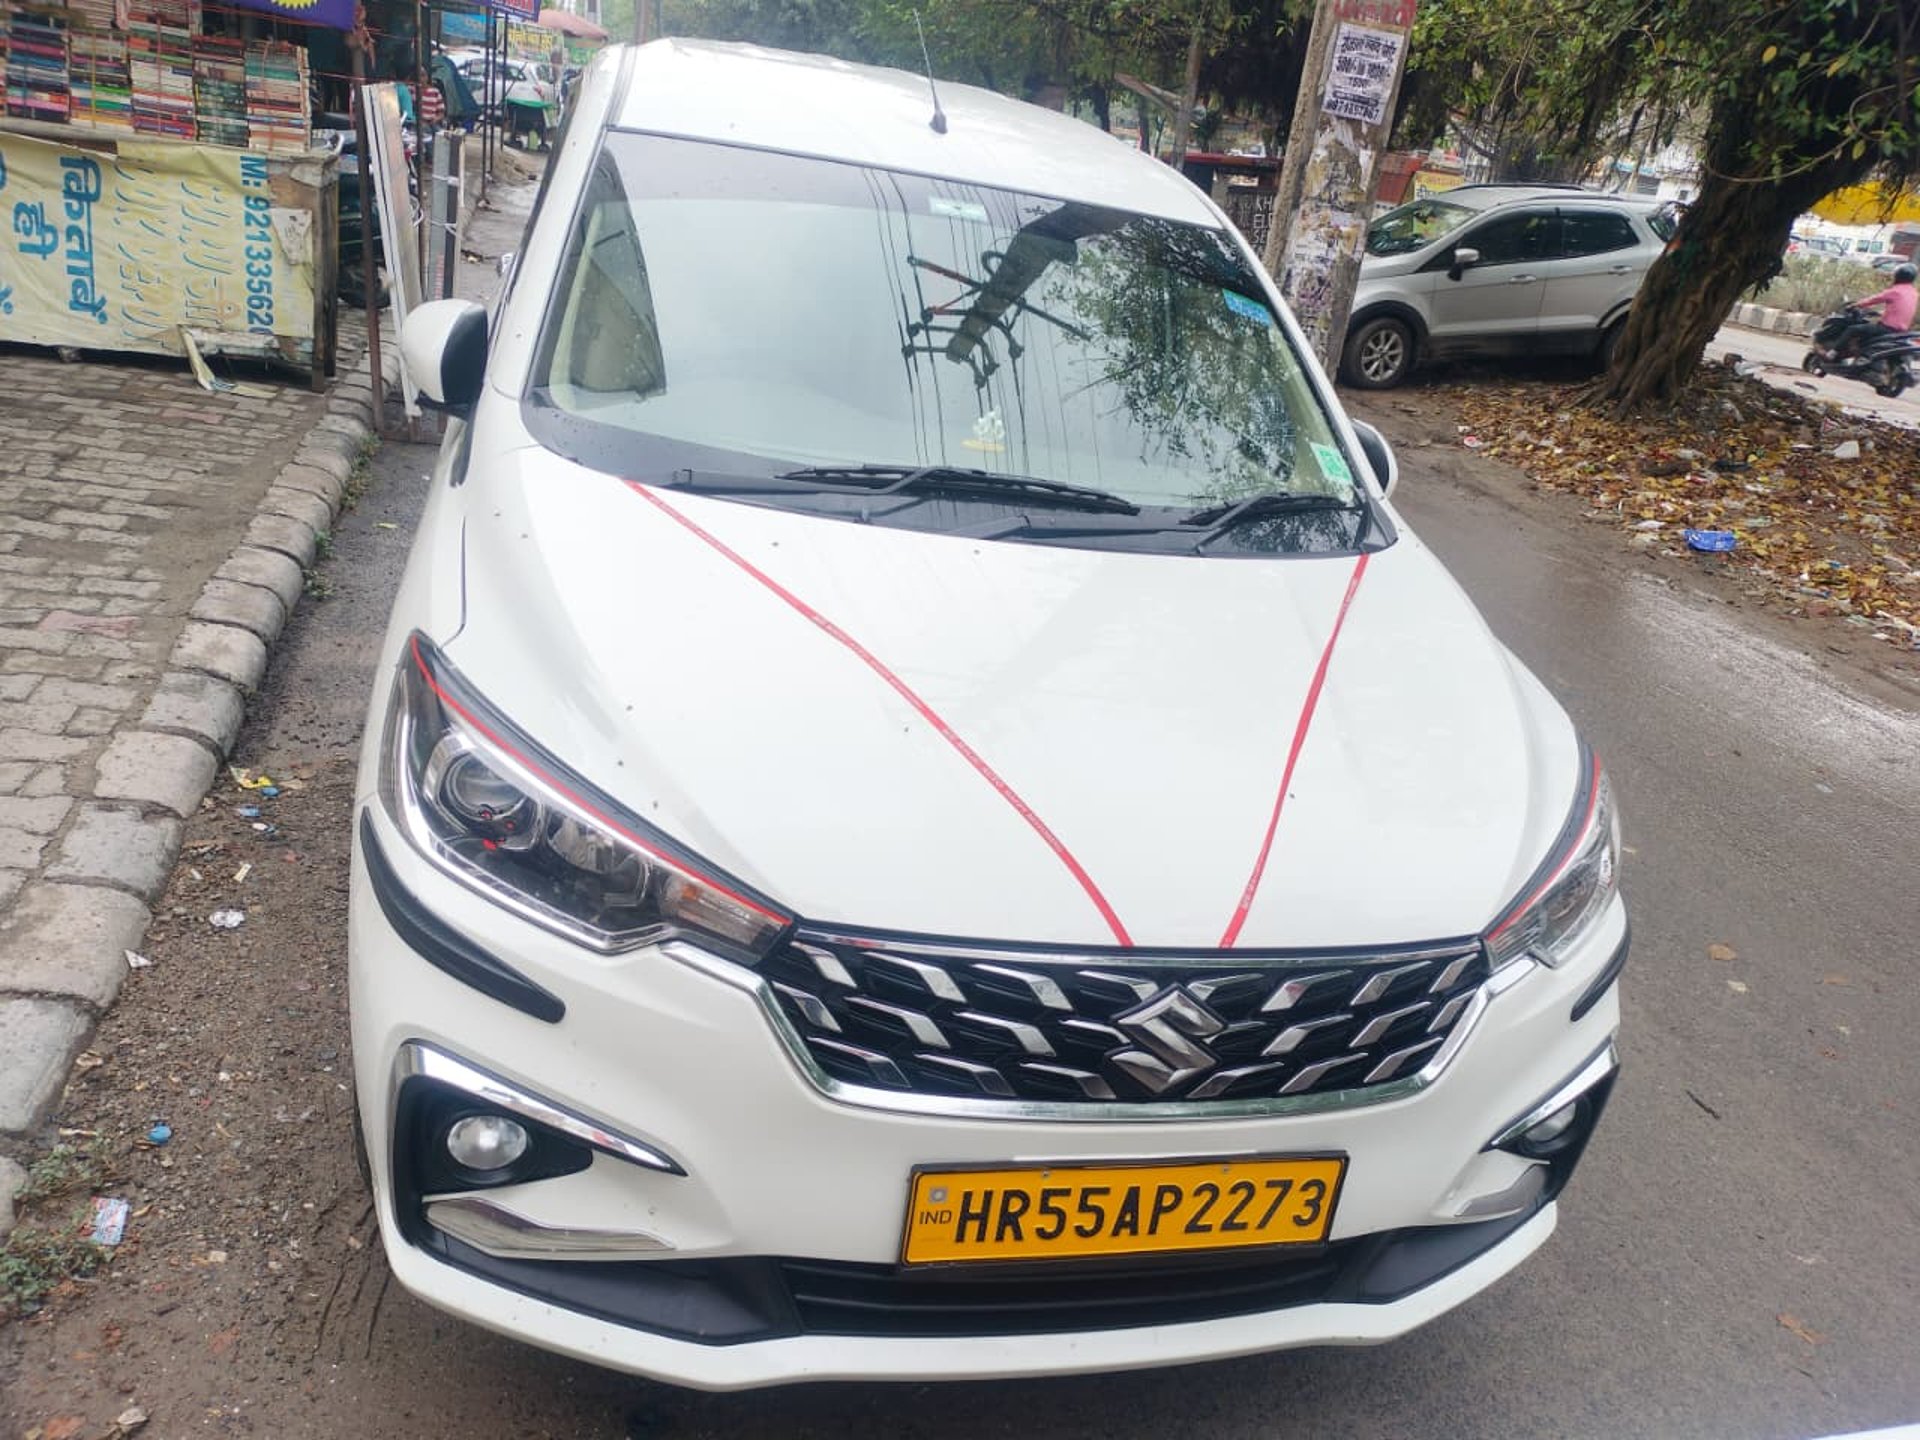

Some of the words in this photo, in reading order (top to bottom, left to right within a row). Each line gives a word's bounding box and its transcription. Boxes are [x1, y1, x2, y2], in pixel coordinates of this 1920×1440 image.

[240, 155, 268, 187] M:
[14, 201, 59, 260] ही
[60, 156, 108, 324] किताबें
[919, 1209, 952, 1225] IND
[954, 1177, 1326, 1243] HR55AP2273
